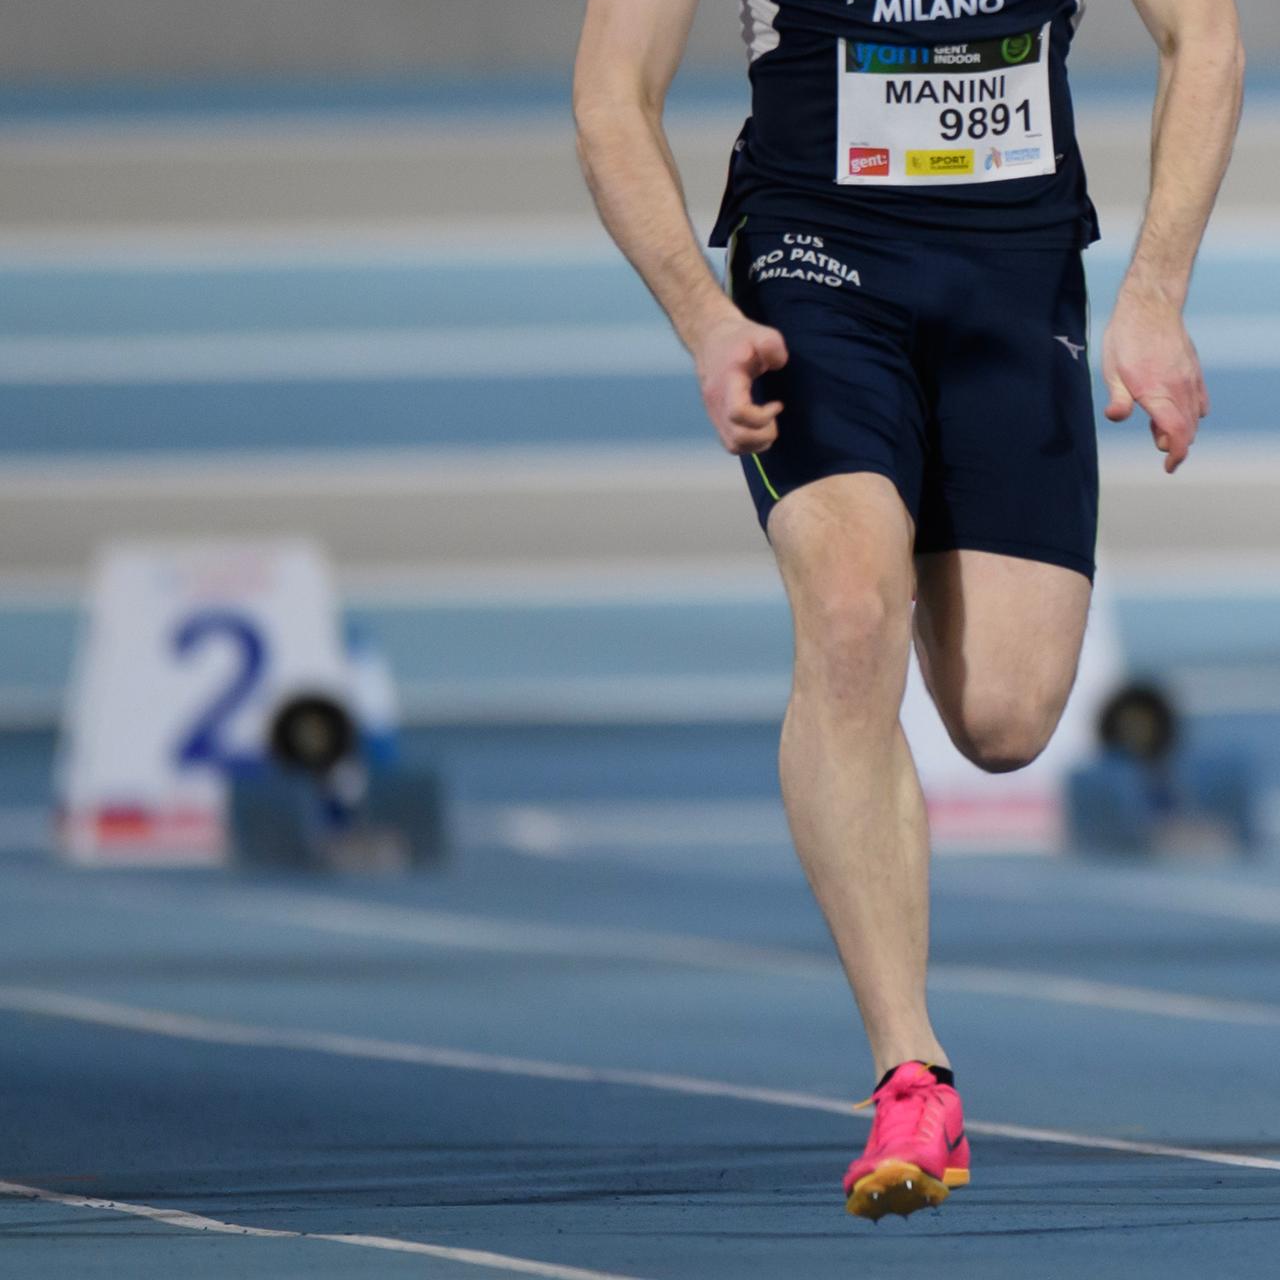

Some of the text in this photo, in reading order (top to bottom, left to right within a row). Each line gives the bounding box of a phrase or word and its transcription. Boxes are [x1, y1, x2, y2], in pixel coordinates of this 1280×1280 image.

[933, 53, 981, 64] INDOOR
[886, 75, 1006, 104] MANINI
[939, 99, 1031, 141] 9891
[783, 233, 824, 248] CUS
[758, 267, 842, 287] MILANO
[790, 248, 860, 286] PATRIA
[171, 606, 274, 776] 2
